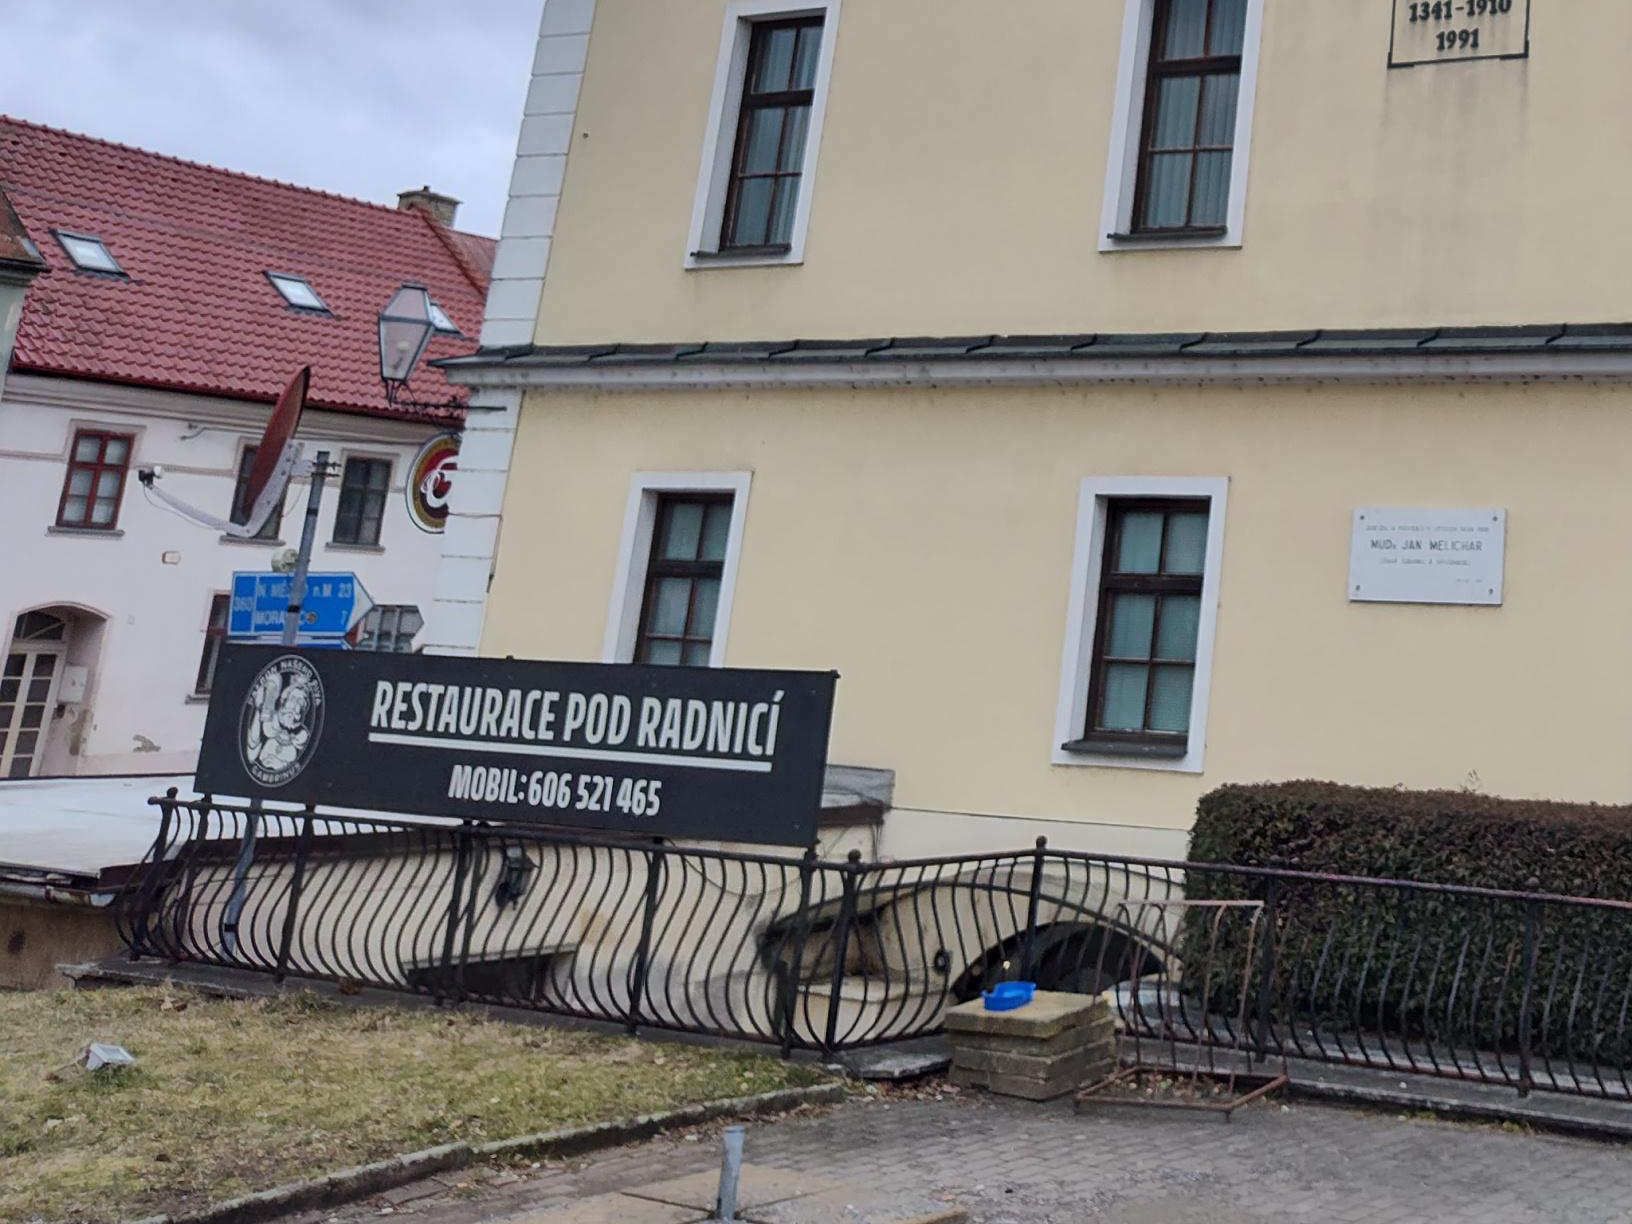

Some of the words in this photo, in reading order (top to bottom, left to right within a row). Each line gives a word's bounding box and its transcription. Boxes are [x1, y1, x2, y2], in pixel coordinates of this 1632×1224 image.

[1436, 27, 1480, 51] 1991
[1401, 539, 1422, 551] JAN
[1429, 539, 1483, 552] MELICHAR
[338, 582, 352, 598] 23
[370, 680, 560, 741] RESTAURACE
[563, 693, 632, 746] POD
[637, 689, 785, 756] RADNICÍ
[575, 774, 614, 812] 521
[615, 777, 662, 816] 465
